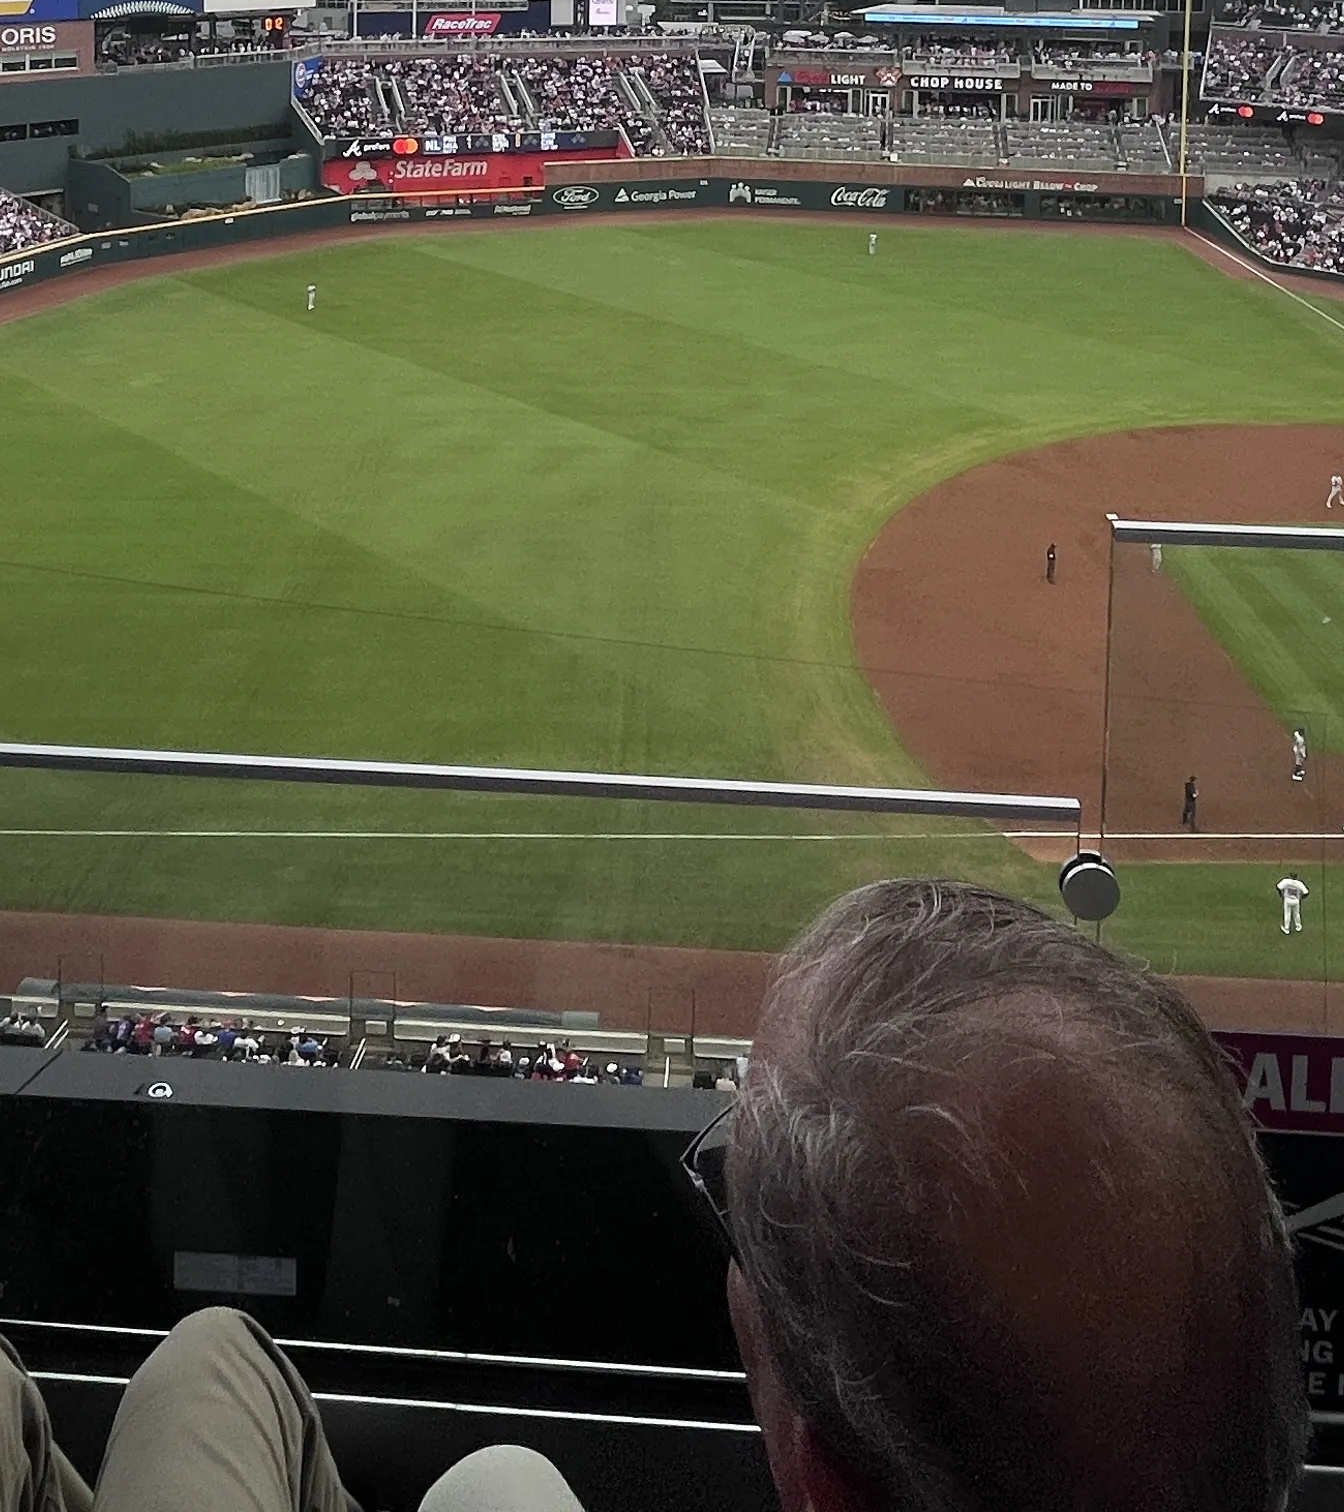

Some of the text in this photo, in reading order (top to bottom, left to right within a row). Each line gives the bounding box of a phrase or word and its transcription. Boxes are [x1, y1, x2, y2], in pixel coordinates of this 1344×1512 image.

[431, 17, 493, 30] RaceTrac
[1, 26, 56, 45] ORIS
[830, 74, 866, 85] LIGHT
[910, 76, 1003, 90] CHOP HOUSE
[1051, 81, 1077, 91] MADE
[1079, 82, 1093, 91] TO
[363, 142, 391, 152] prefers
[560, 189, 591, 203] Ford
[631, 189, 697, 202] Georgia Power
